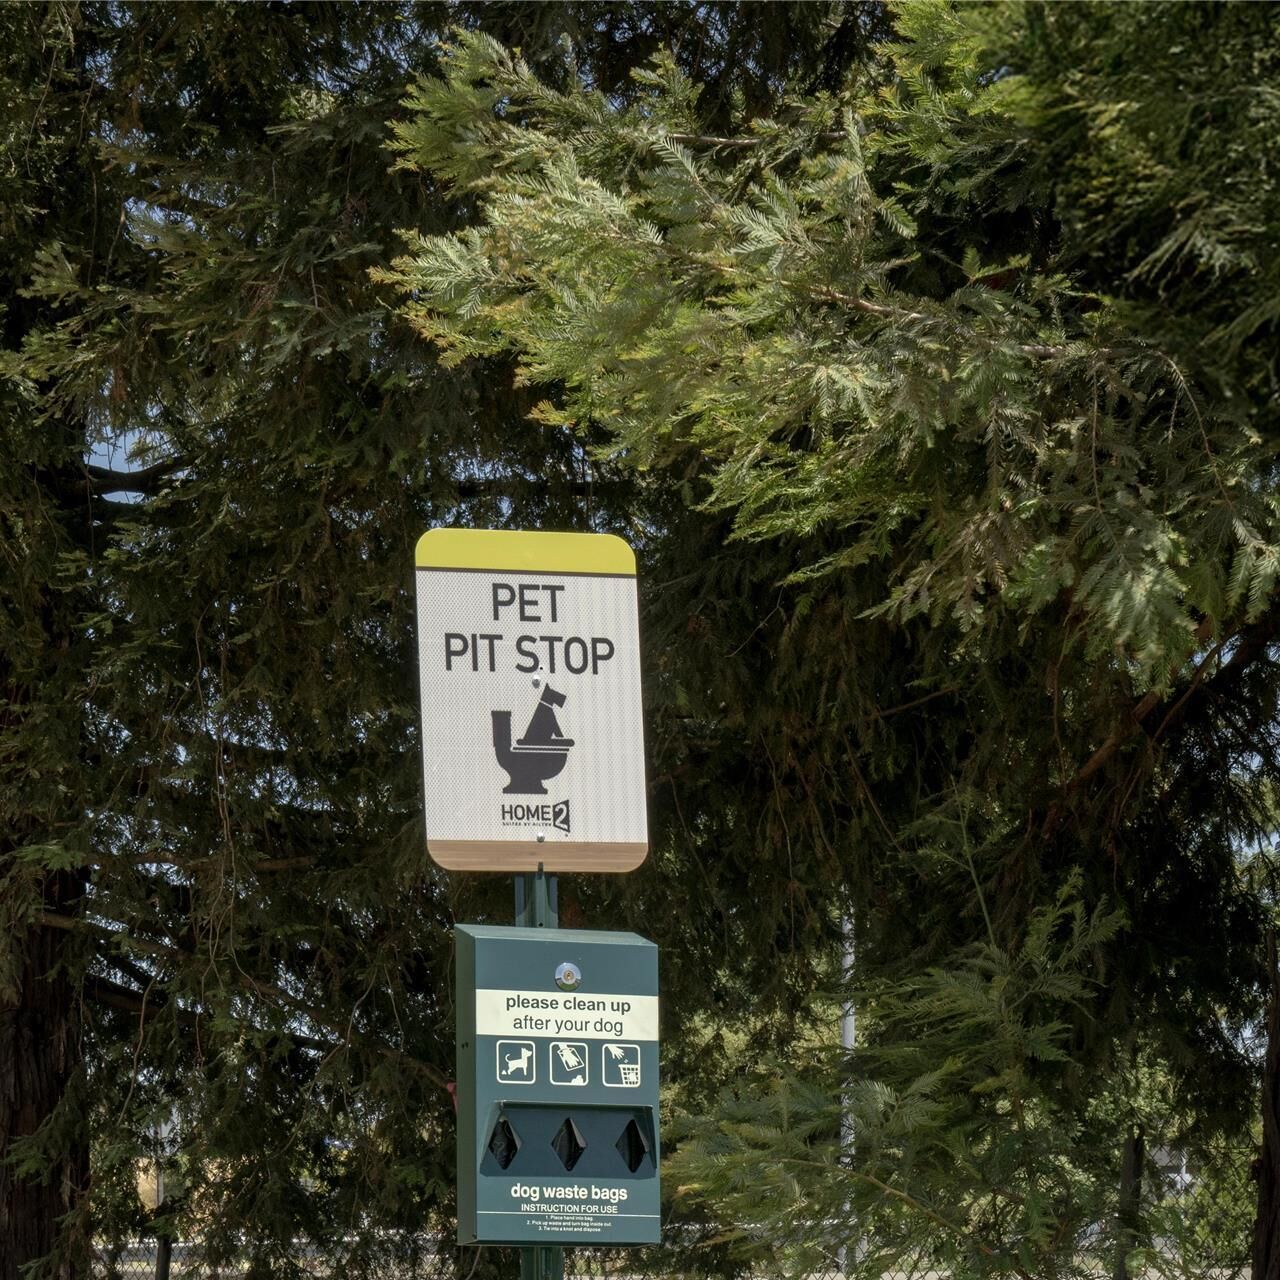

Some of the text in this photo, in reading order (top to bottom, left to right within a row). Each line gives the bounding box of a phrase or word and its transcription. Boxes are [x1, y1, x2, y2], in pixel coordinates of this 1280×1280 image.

[492, 582, 565, 623] PET
[444, 632, 615, 675] PIT STOP
[506, 995, 631, 1015] please clean up
[513, 1015, 623, 1036] after your dog
[511, 1183, 628, 1203] dog waste bags
[521, 1204, 618, 1214] INSTRUCTION FOR USE
